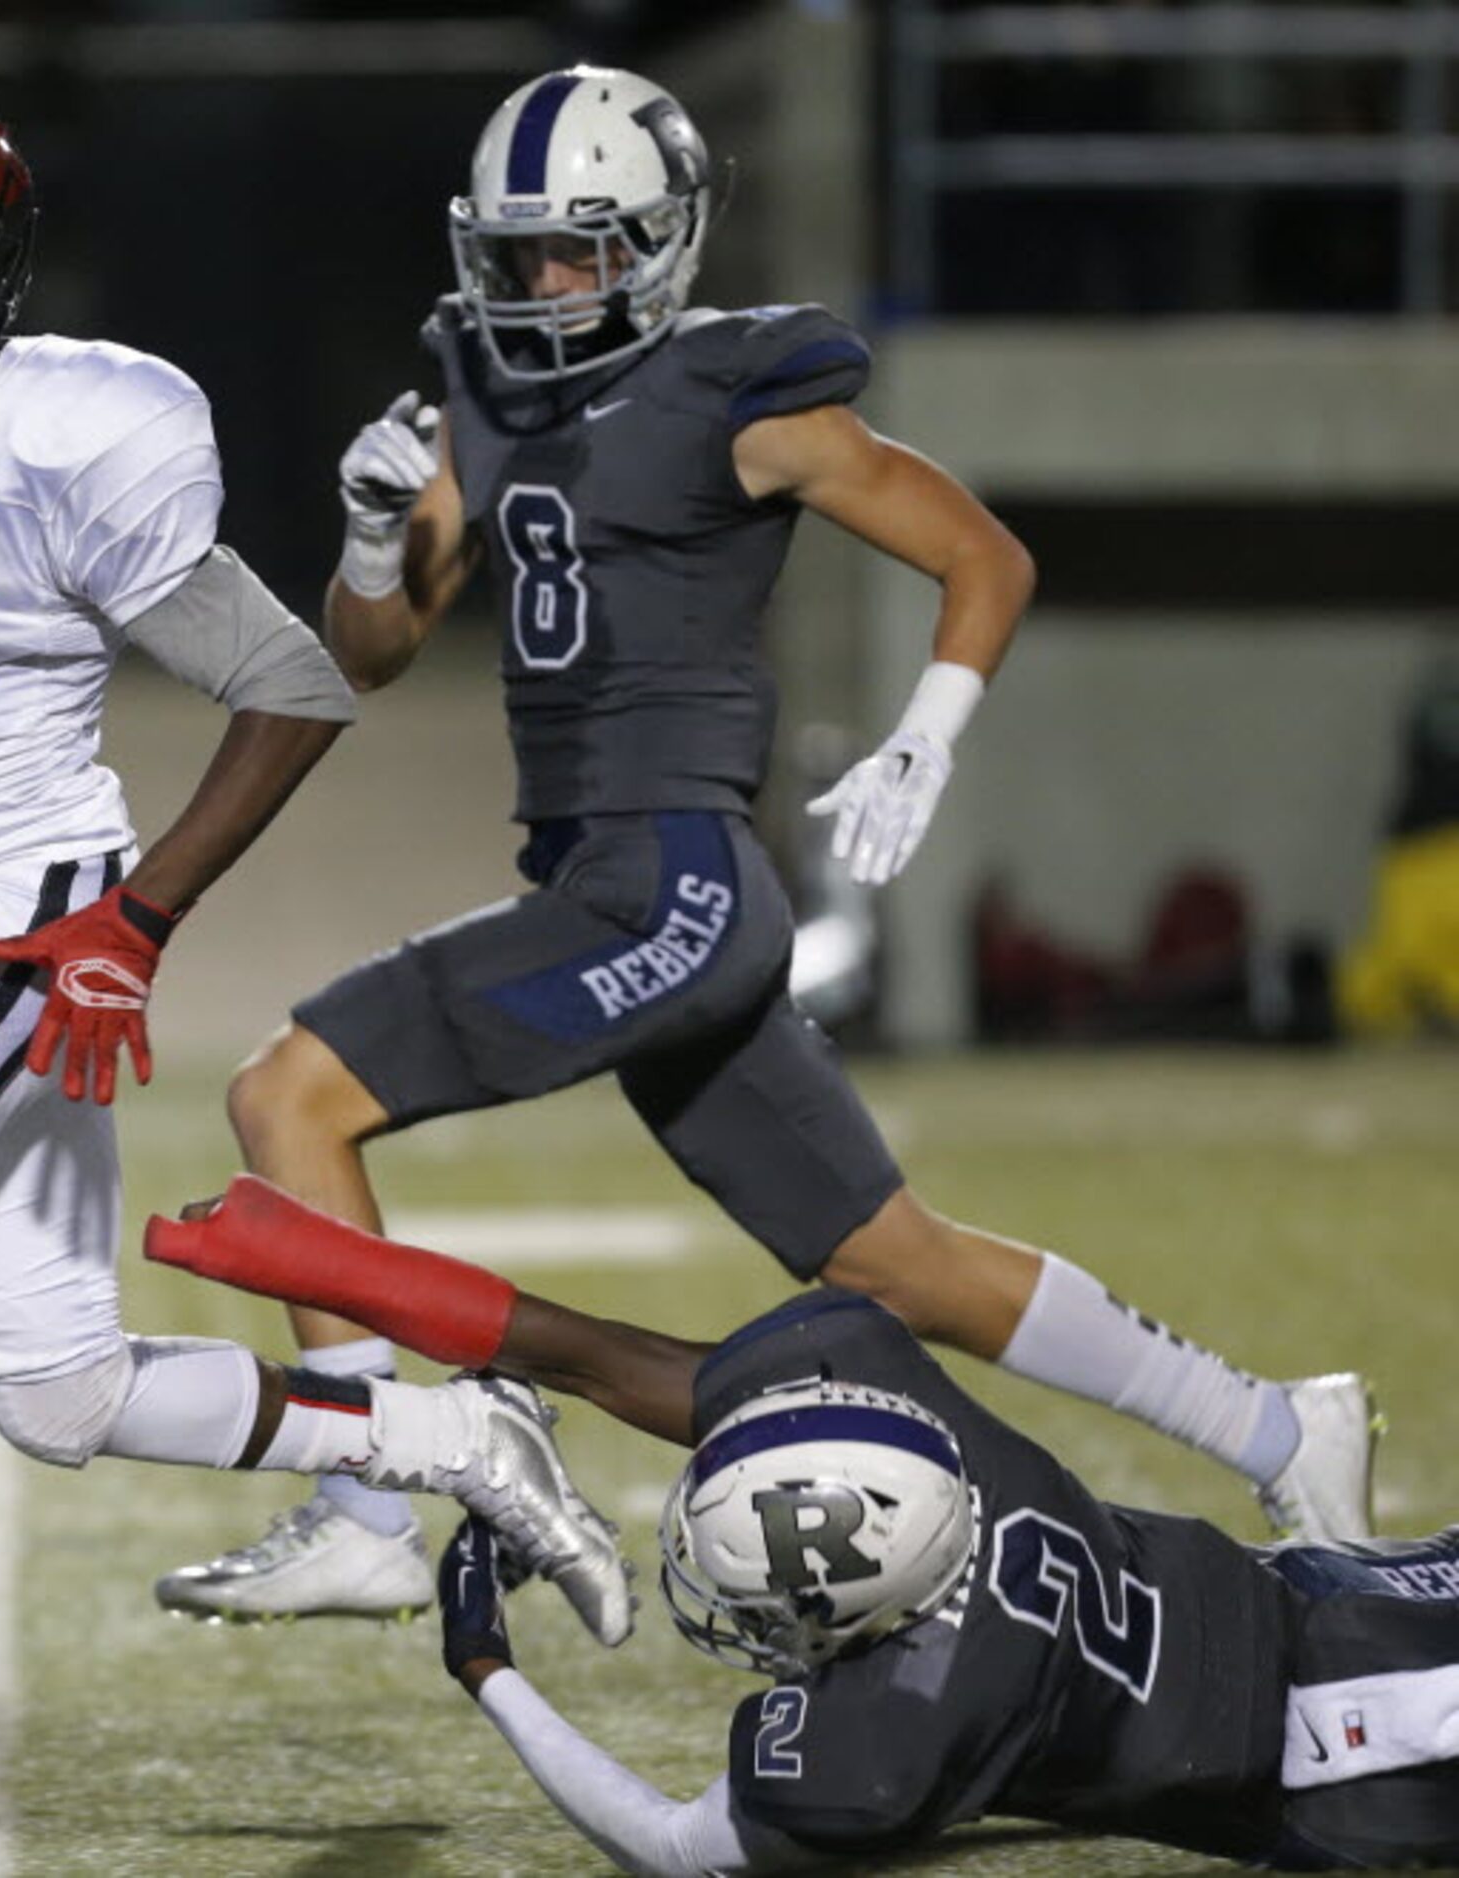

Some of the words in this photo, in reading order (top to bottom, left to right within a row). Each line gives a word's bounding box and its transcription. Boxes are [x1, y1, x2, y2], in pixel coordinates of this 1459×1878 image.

[498, 484, 587, 669] 8
[580, 873, 733, 1019] REBELS
[752, 1484, 882, 1594] R
[987, 1506, 1163, 1704] 2
[754, 1686, 808, 1778] 2
